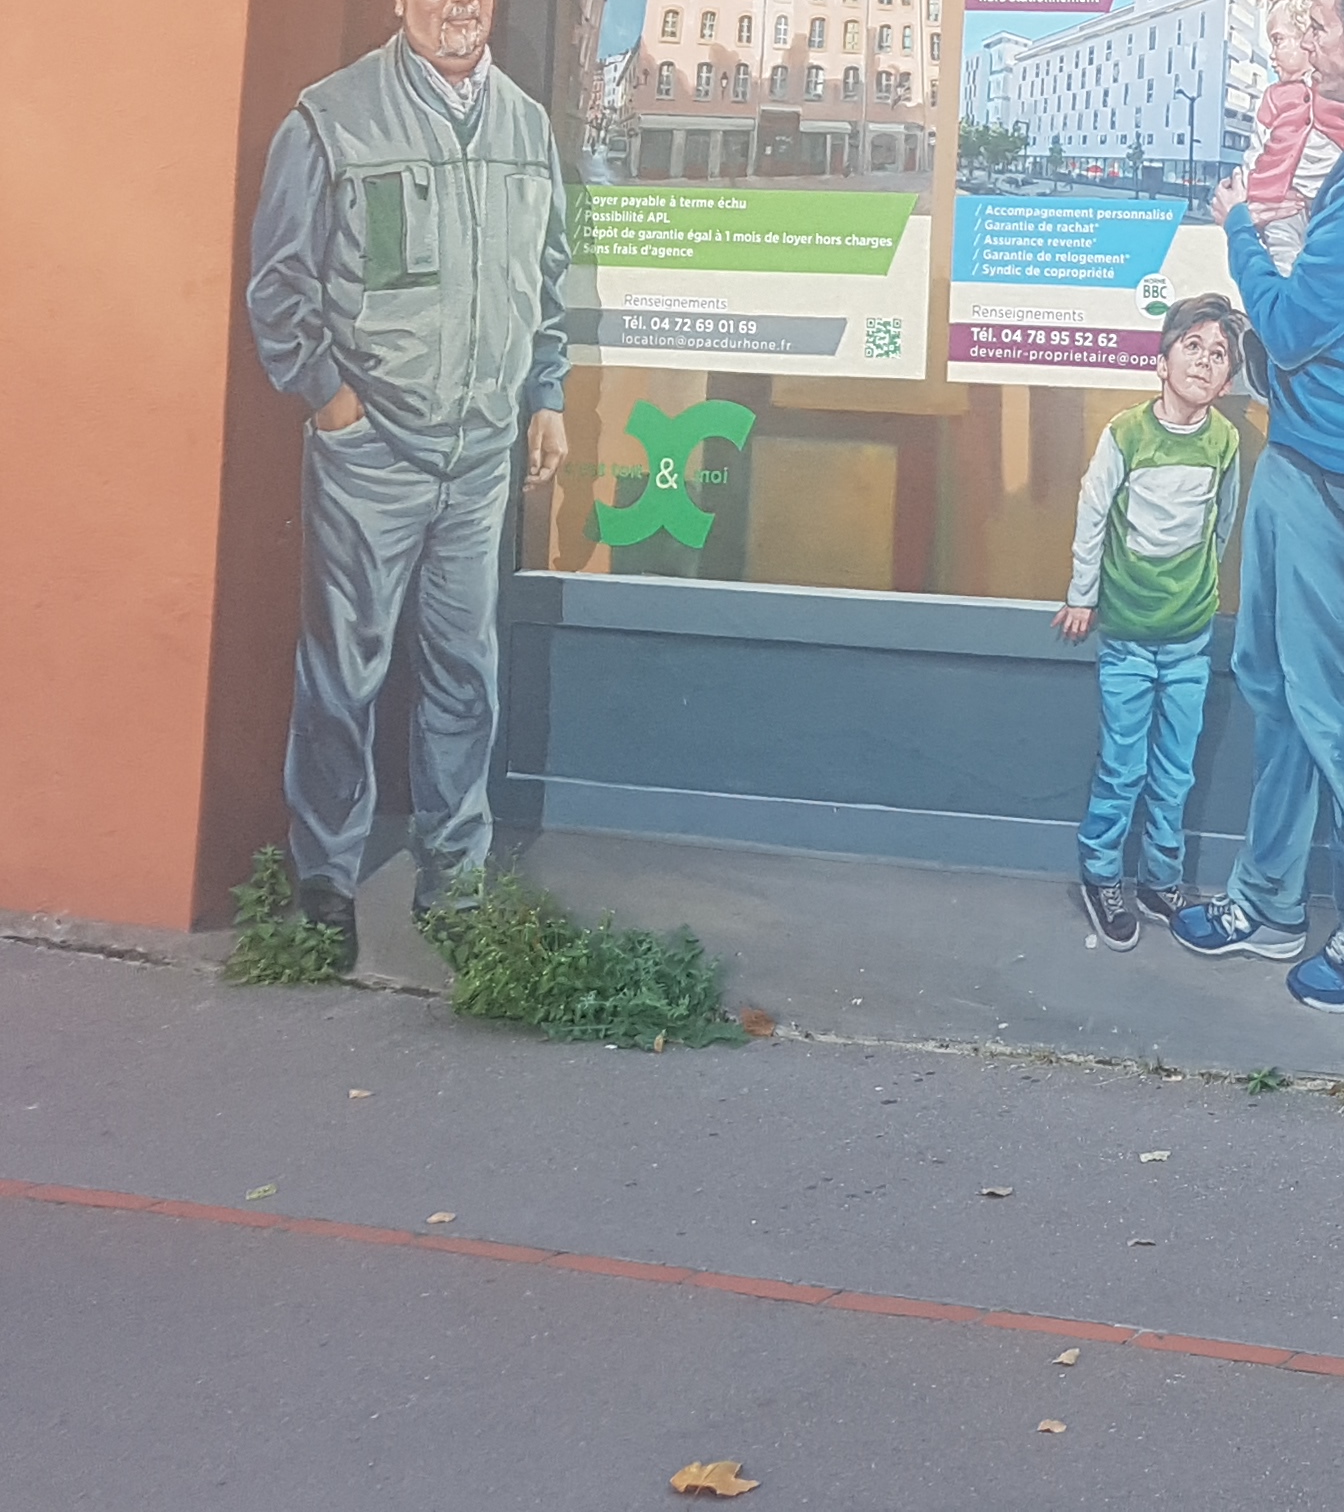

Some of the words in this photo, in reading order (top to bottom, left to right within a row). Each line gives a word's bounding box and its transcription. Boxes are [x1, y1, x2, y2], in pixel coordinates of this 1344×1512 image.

[621, 195, 666, 210] payable
[679, 196, 715, 209] terme
[717, 196, 747, 210] échu
[647, 212, 671, 224] APL
[985, 204, 1094, 220] Accompagnement
[1097, 208, 1174, 222] personnalisé
[984, 219, 1035, 232] Garantie
[1038, 221, 1053, 232] de
[583, 226, 618, 241] Dépôt
[621, 227, 636, 240] de
[638, 228, 684, 242] garantie
[687, 229, 712, 244] égal
[733, 230, 761, 243] mois
[764, 231, 780, 244] de
[783, 232, 813, 248] loyer
[815, 233, 842, 246] hors
[845, 234, 893, 250] charges
[984, 234, 1044, 247] Assurance
[613, 242, 638, 256] frais
[640, 243, 694, 259] d'agence
[982, 249, 1034, 261] Garantie
[1036, 250, 1052, 262] de
[982, 263, 1022, 277] Syndic
[1025, 265, 1041, 276] de
[1043, 266, 1115, 280] copropriété
[1143, 284, 1167, 299] BBC
[624, 293, 728, 311] Renseignements
[971, 304, 1084, 322] Renseignements
[623, 316, 646, 330] Tél.
[650, 317, 670, 331] 04
[674, 318, 691, 332] 72
[695, 319, 714, 333] 69
[718, 319, 734, 334] 01
[738, 320, 757, 335] 69
[621, 332, 792, 352] location@opacdurhone.fr
[970, 327, 997, 342] Tél.
[1001, 329, 1022, 343] 04
[1027, 330, 1046, 344] 78
[1050, 331, 1070, 345] 95
[1074, 332, 1093, 346] 52
[1097, 333, 1118, 347] 62
[655, 457, 679, 489] &
